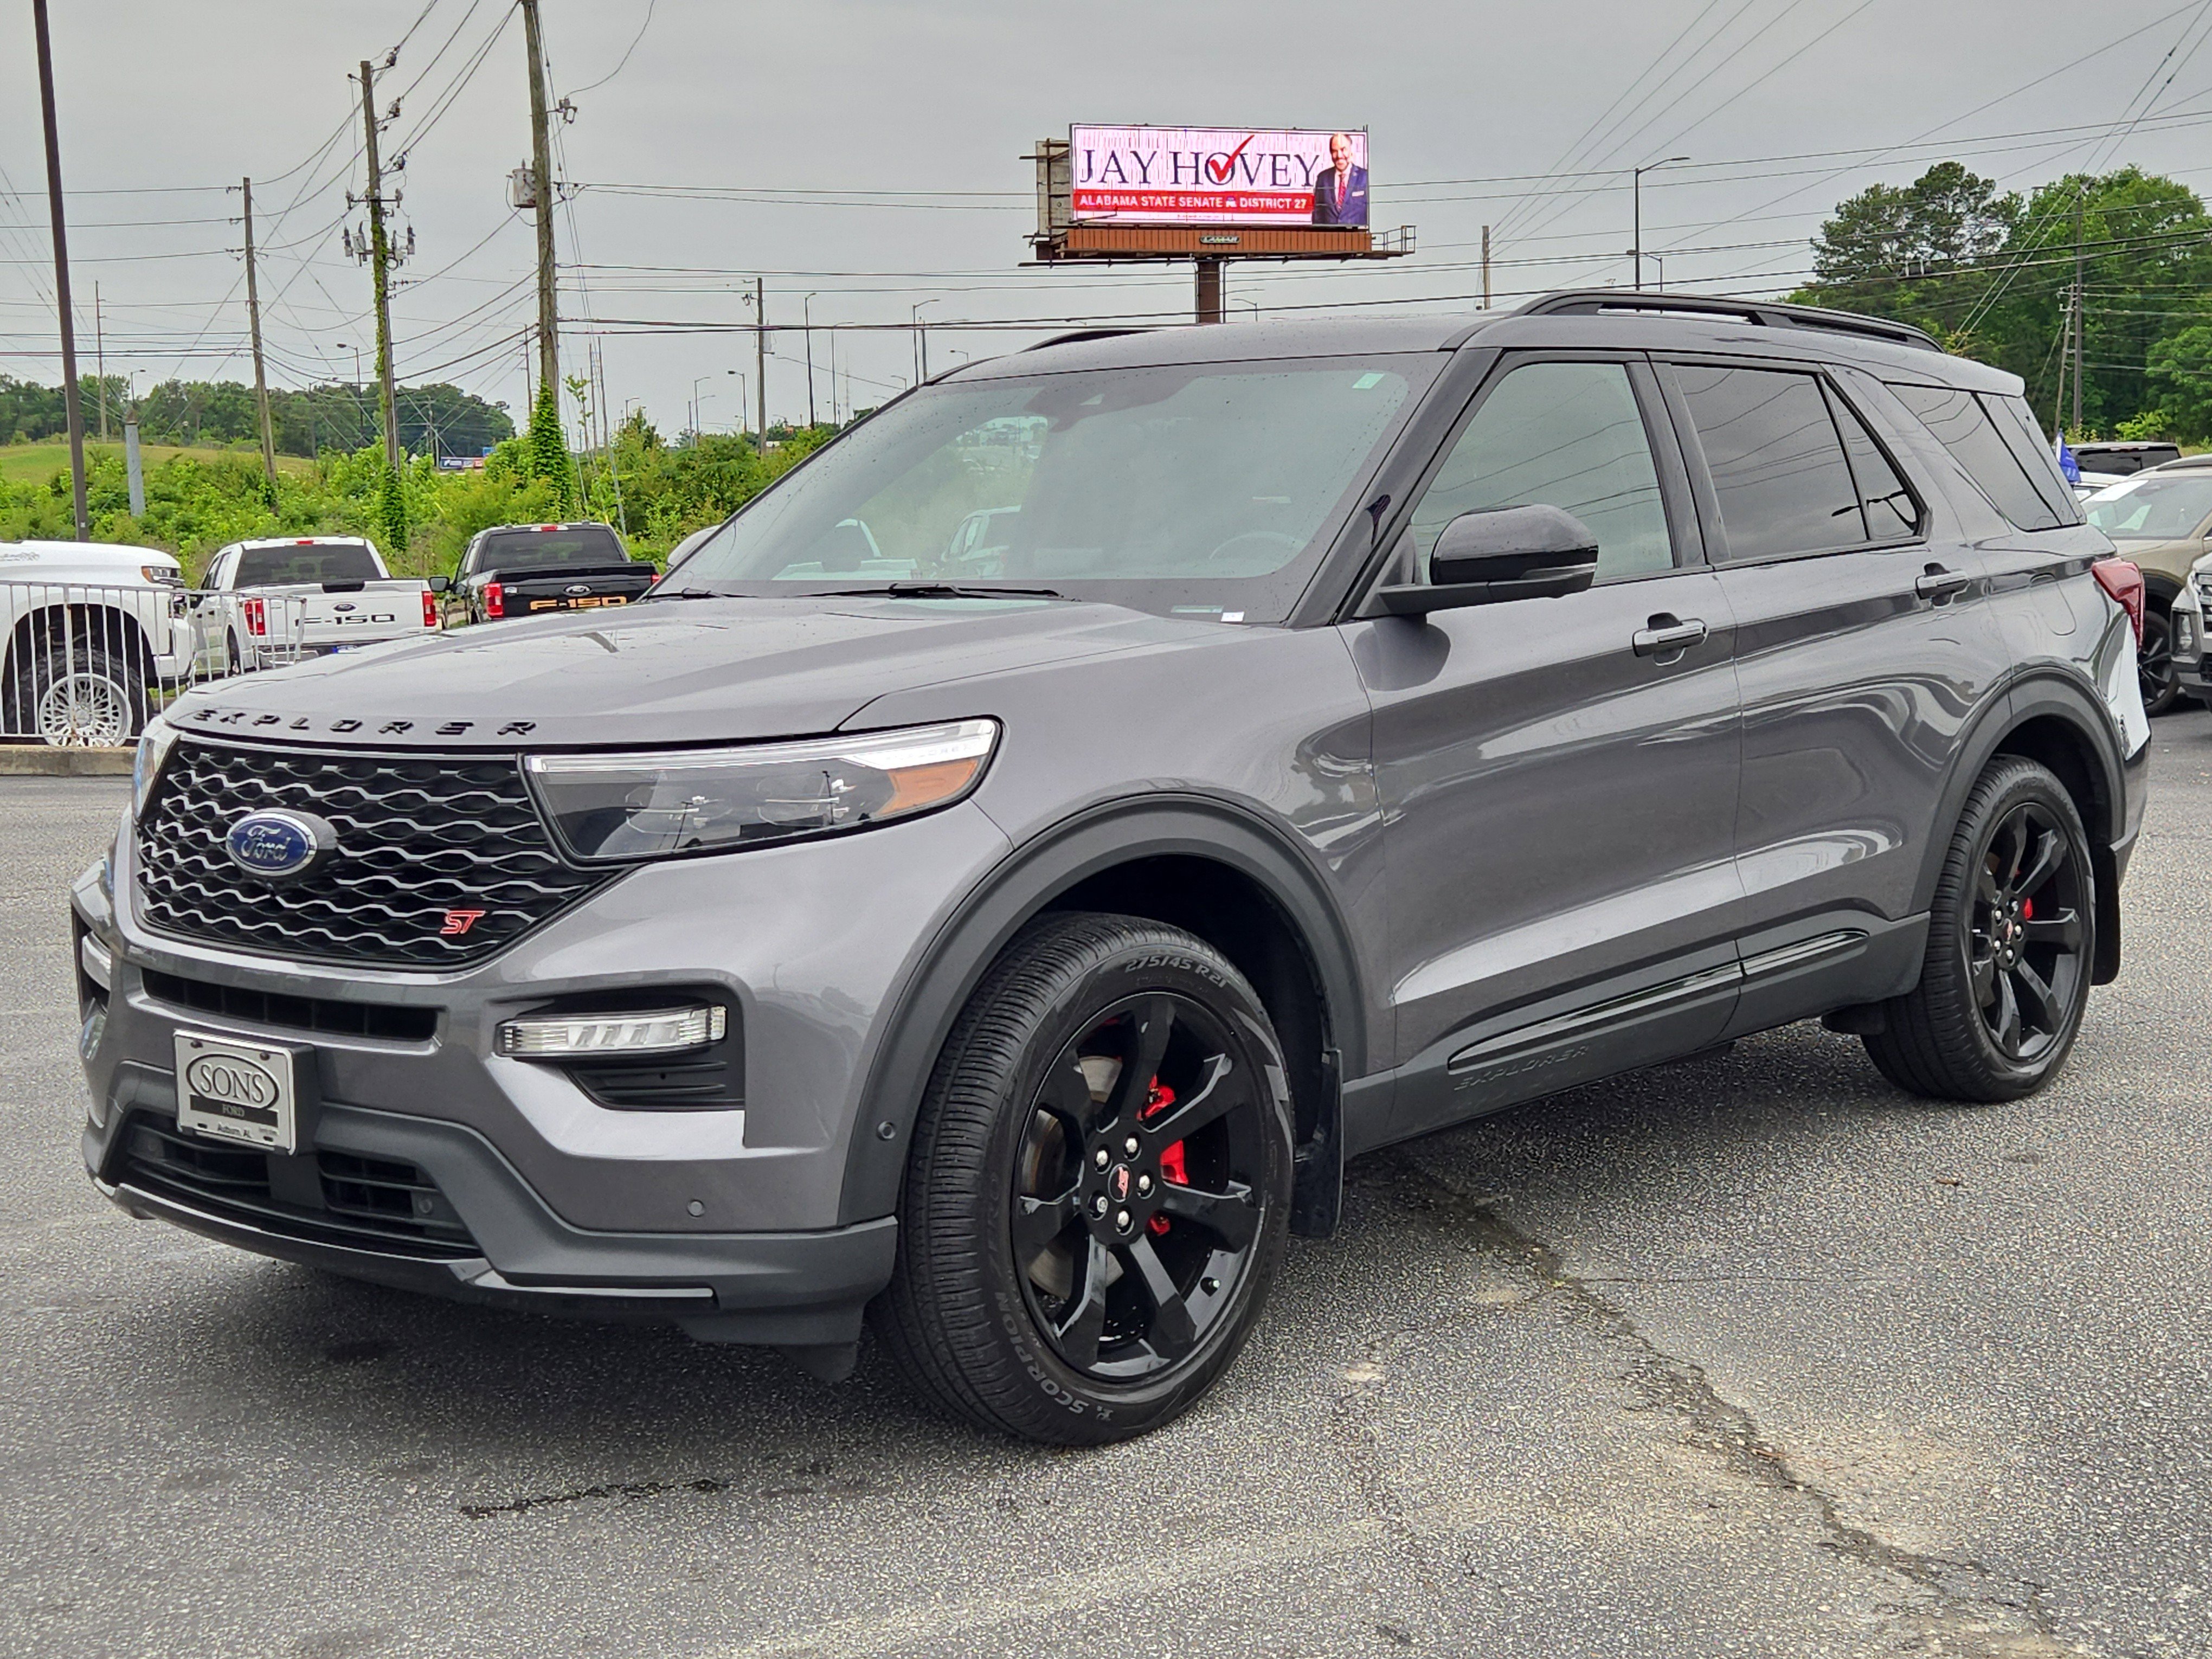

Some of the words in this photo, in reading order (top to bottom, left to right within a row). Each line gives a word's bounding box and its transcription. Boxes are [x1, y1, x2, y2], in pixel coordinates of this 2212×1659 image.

[1080, 150, 1157, 184] JAY
[1169, 150, 1320, 187] HOVEY
[1079, 195, 1138, 207] ALABAMA
[1141, 196, 1176, 207] STATE
[1179, 196, 1223, 208] SENATE
[1239, 197, 1292, 209] DISTRICT
[1294, 198, 1307, 209] 27
[530, 596, 627, 610] F-150
[295, 614, 395, 627] F-150
[192, 709, 536, 735] EXPLORER
[241, 825, 292, 861] Ford
[440, 910, 487, 934] ST
[1124, 955, 1193, 973] 275/45
[1454, 1045, 1589, 1091] EXPLORER
[200, 1063, 265, 1103] SONS
[222, 1103, 245, 1117] FORD
[994, 1292, 1090, 1414] SCORPION
